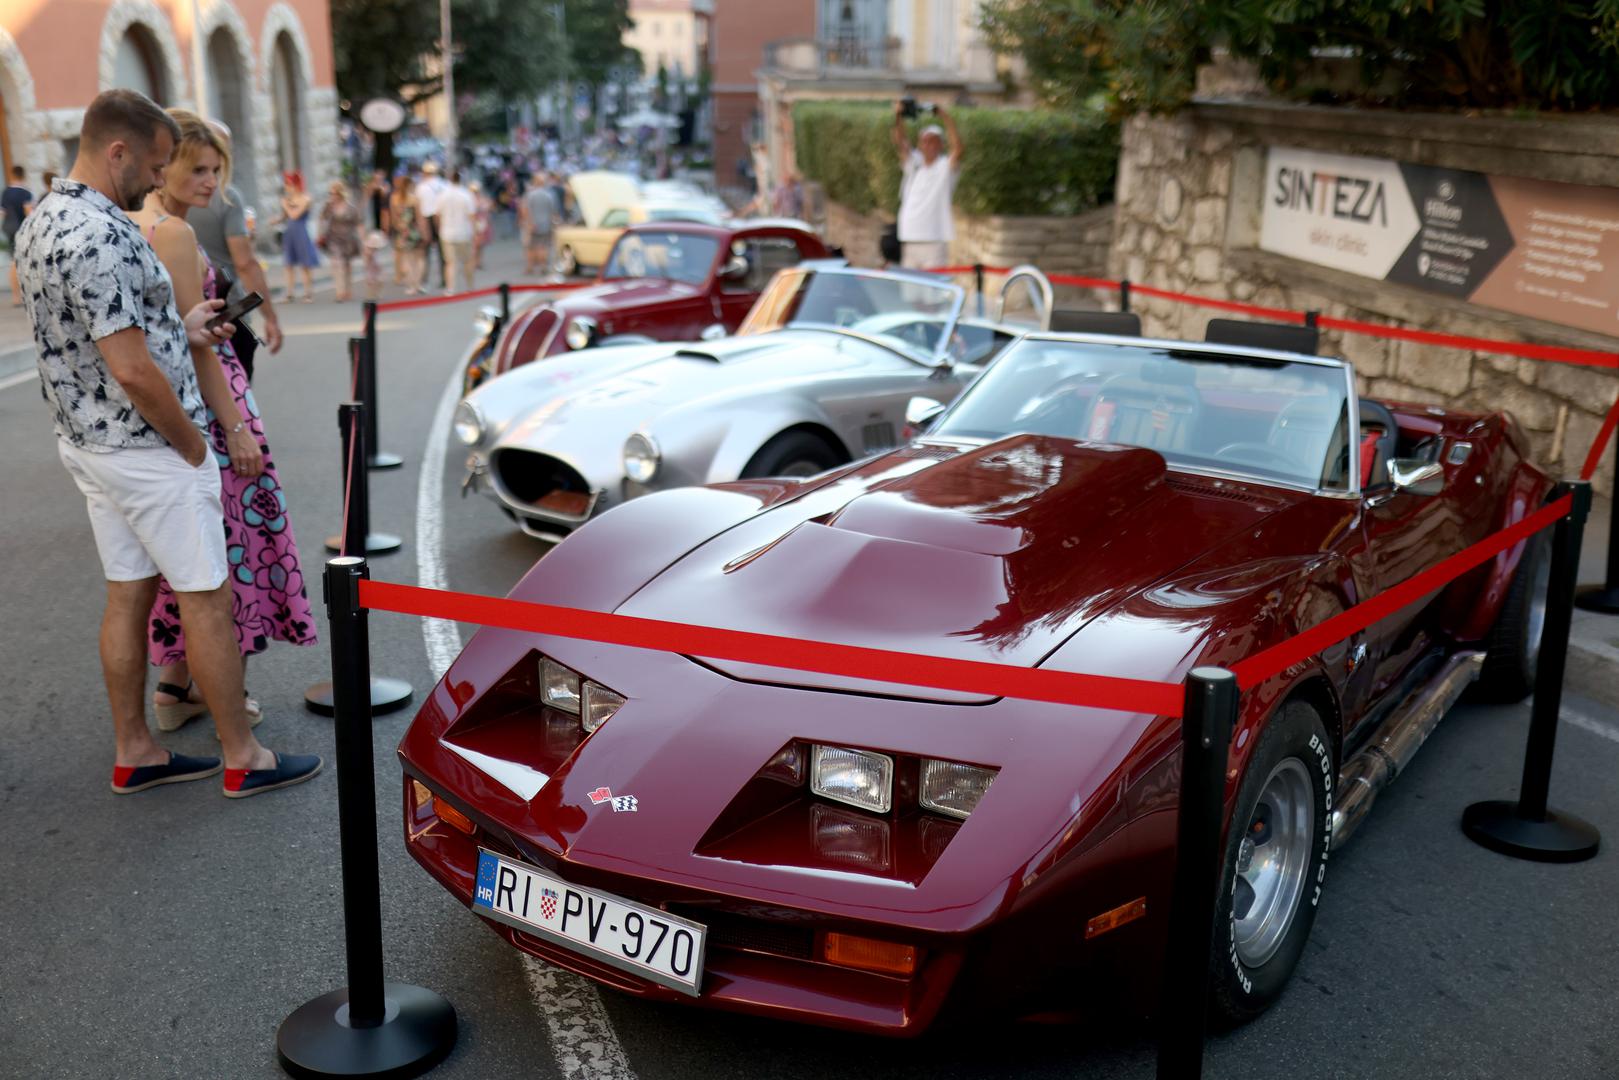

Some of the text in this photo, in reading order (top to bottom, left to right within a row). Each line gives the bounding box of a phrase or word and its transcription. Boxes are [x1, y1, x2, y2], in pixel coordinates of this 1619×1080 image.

[1274, 167, 1388, 227] SINTEZA
[1425, 200, 1462, 221] Hilton
[1310, 227, 1369, 256] skin clinic
[477, 885, 493, 903] HR
[496, 866, 694, 976] RI PV-970
